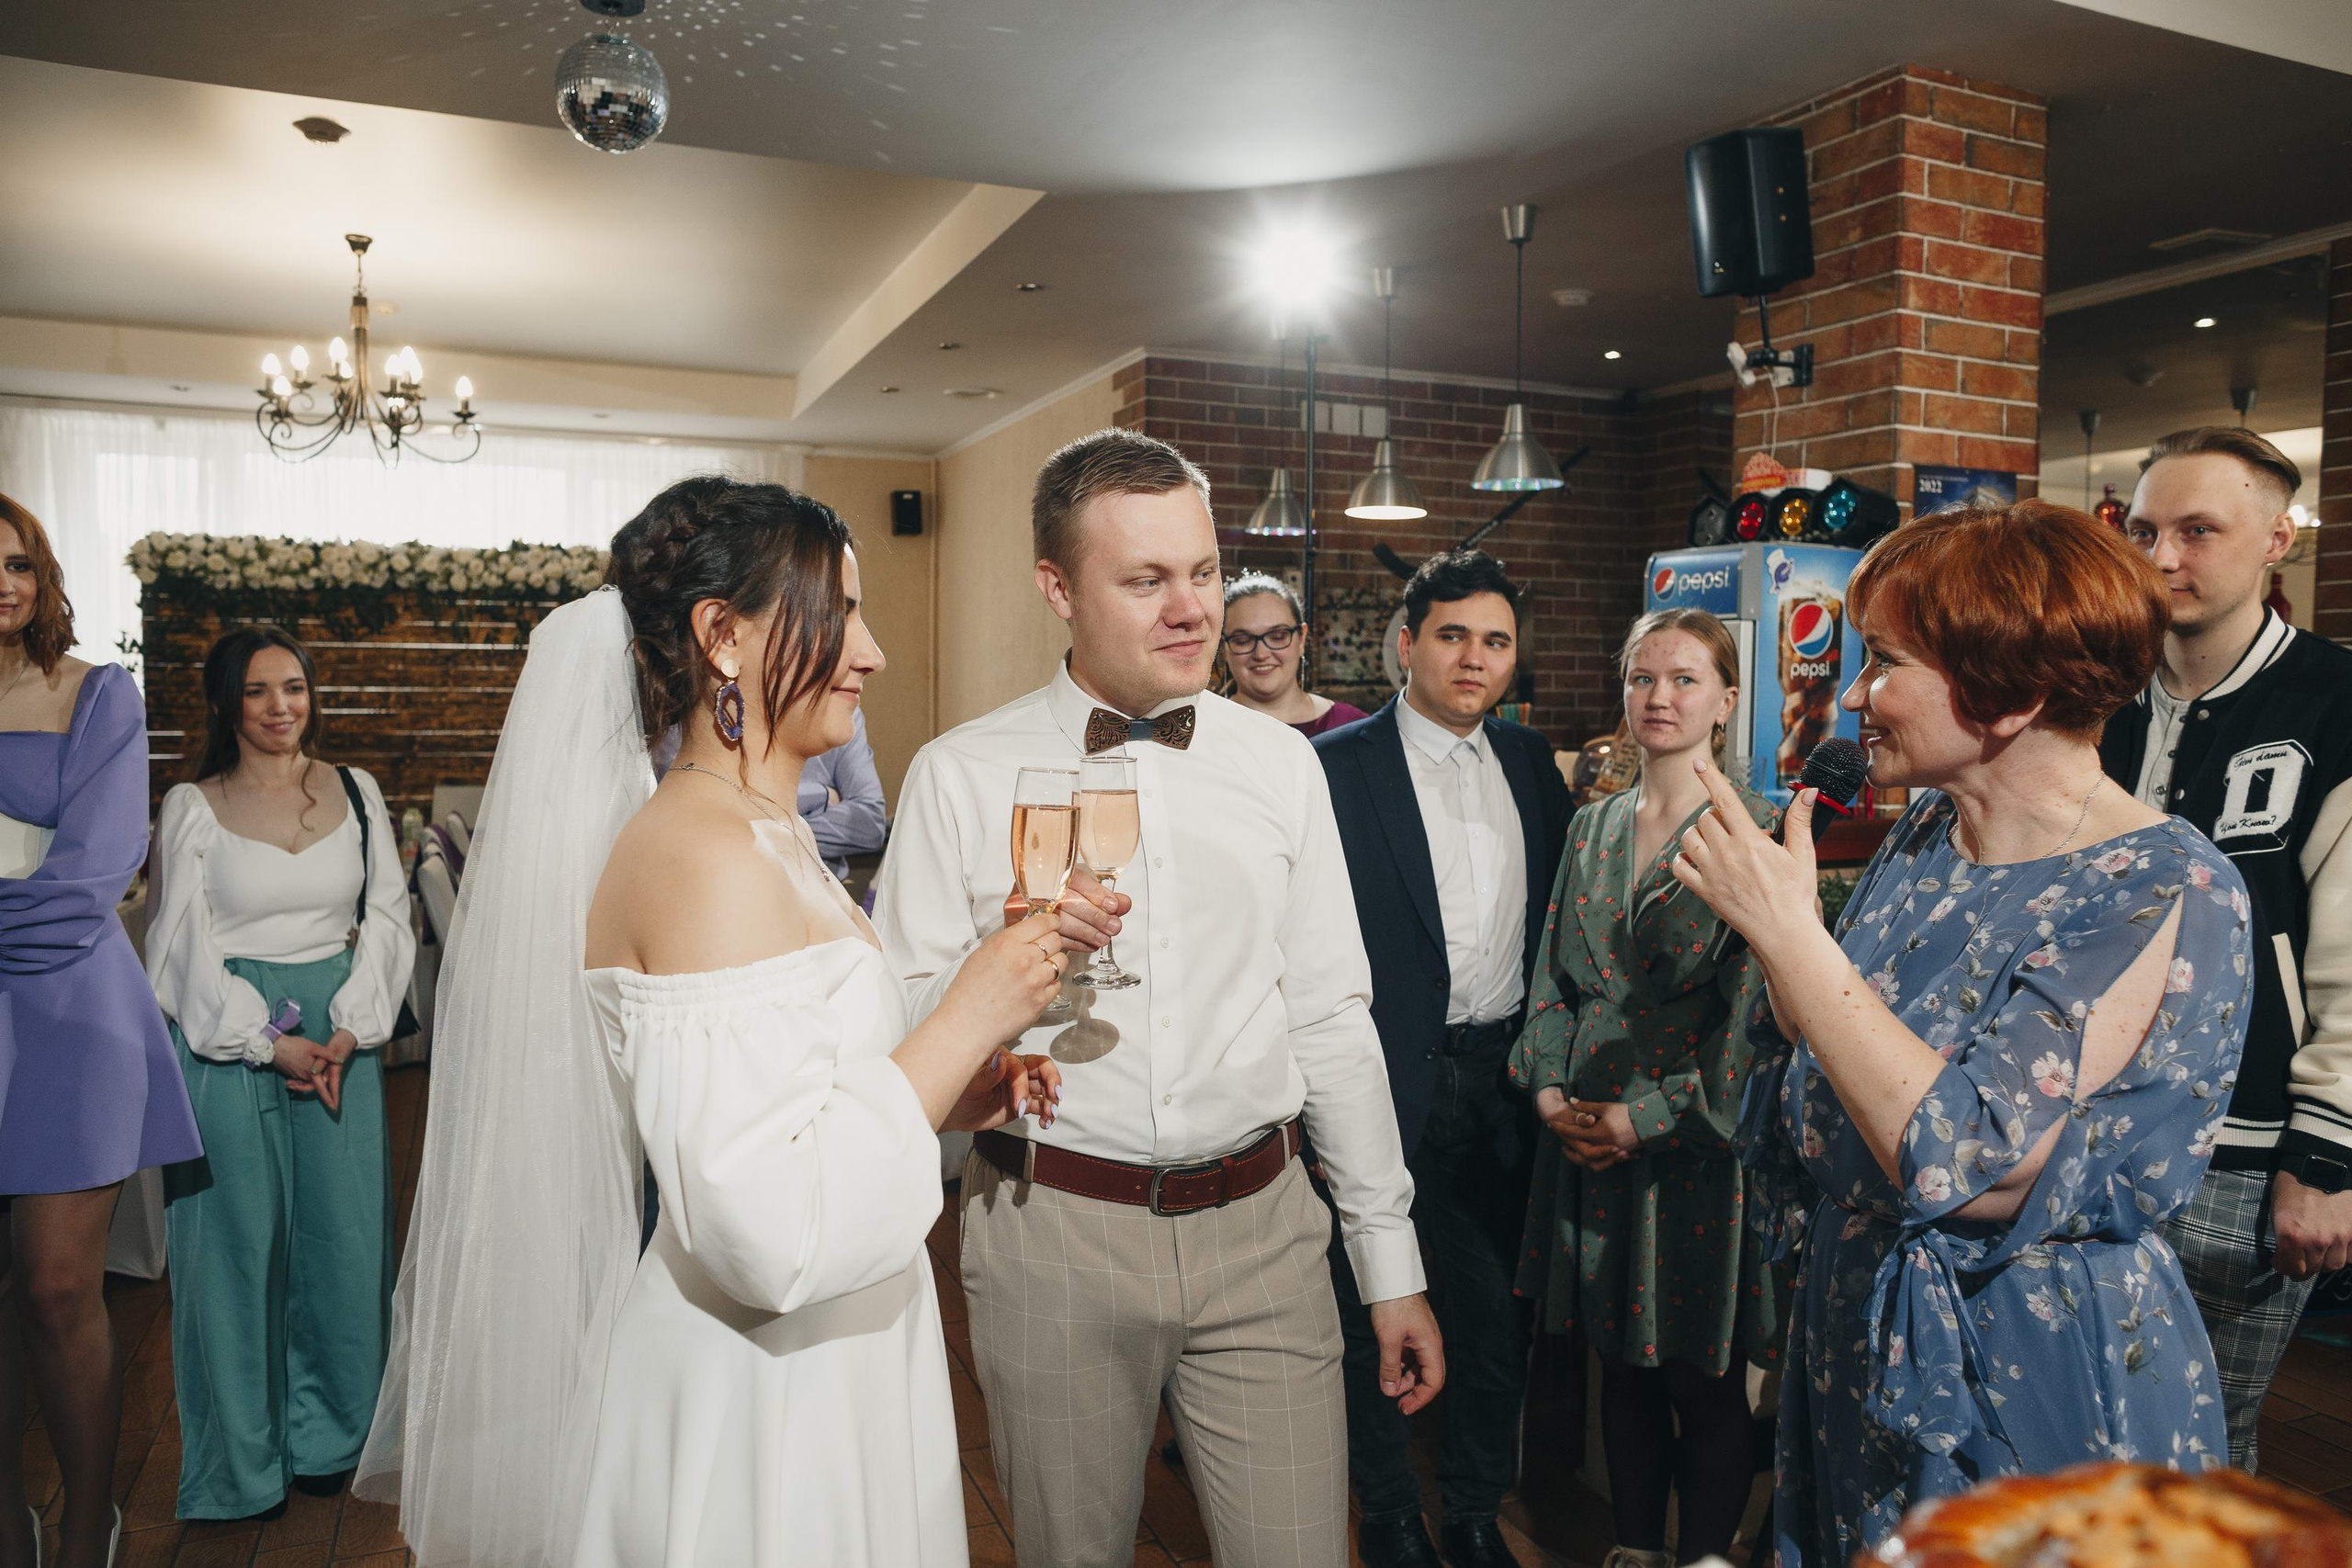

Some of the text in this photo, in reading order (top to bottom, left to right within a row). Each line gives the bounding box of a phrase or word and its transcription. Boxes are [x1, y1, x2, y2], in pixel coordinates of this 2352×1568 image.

[1919, 479, 1942, 493] 2022
[1678, 565, 1730, 596] pepsi
[1790, 660, 1830, 680] pepsi
